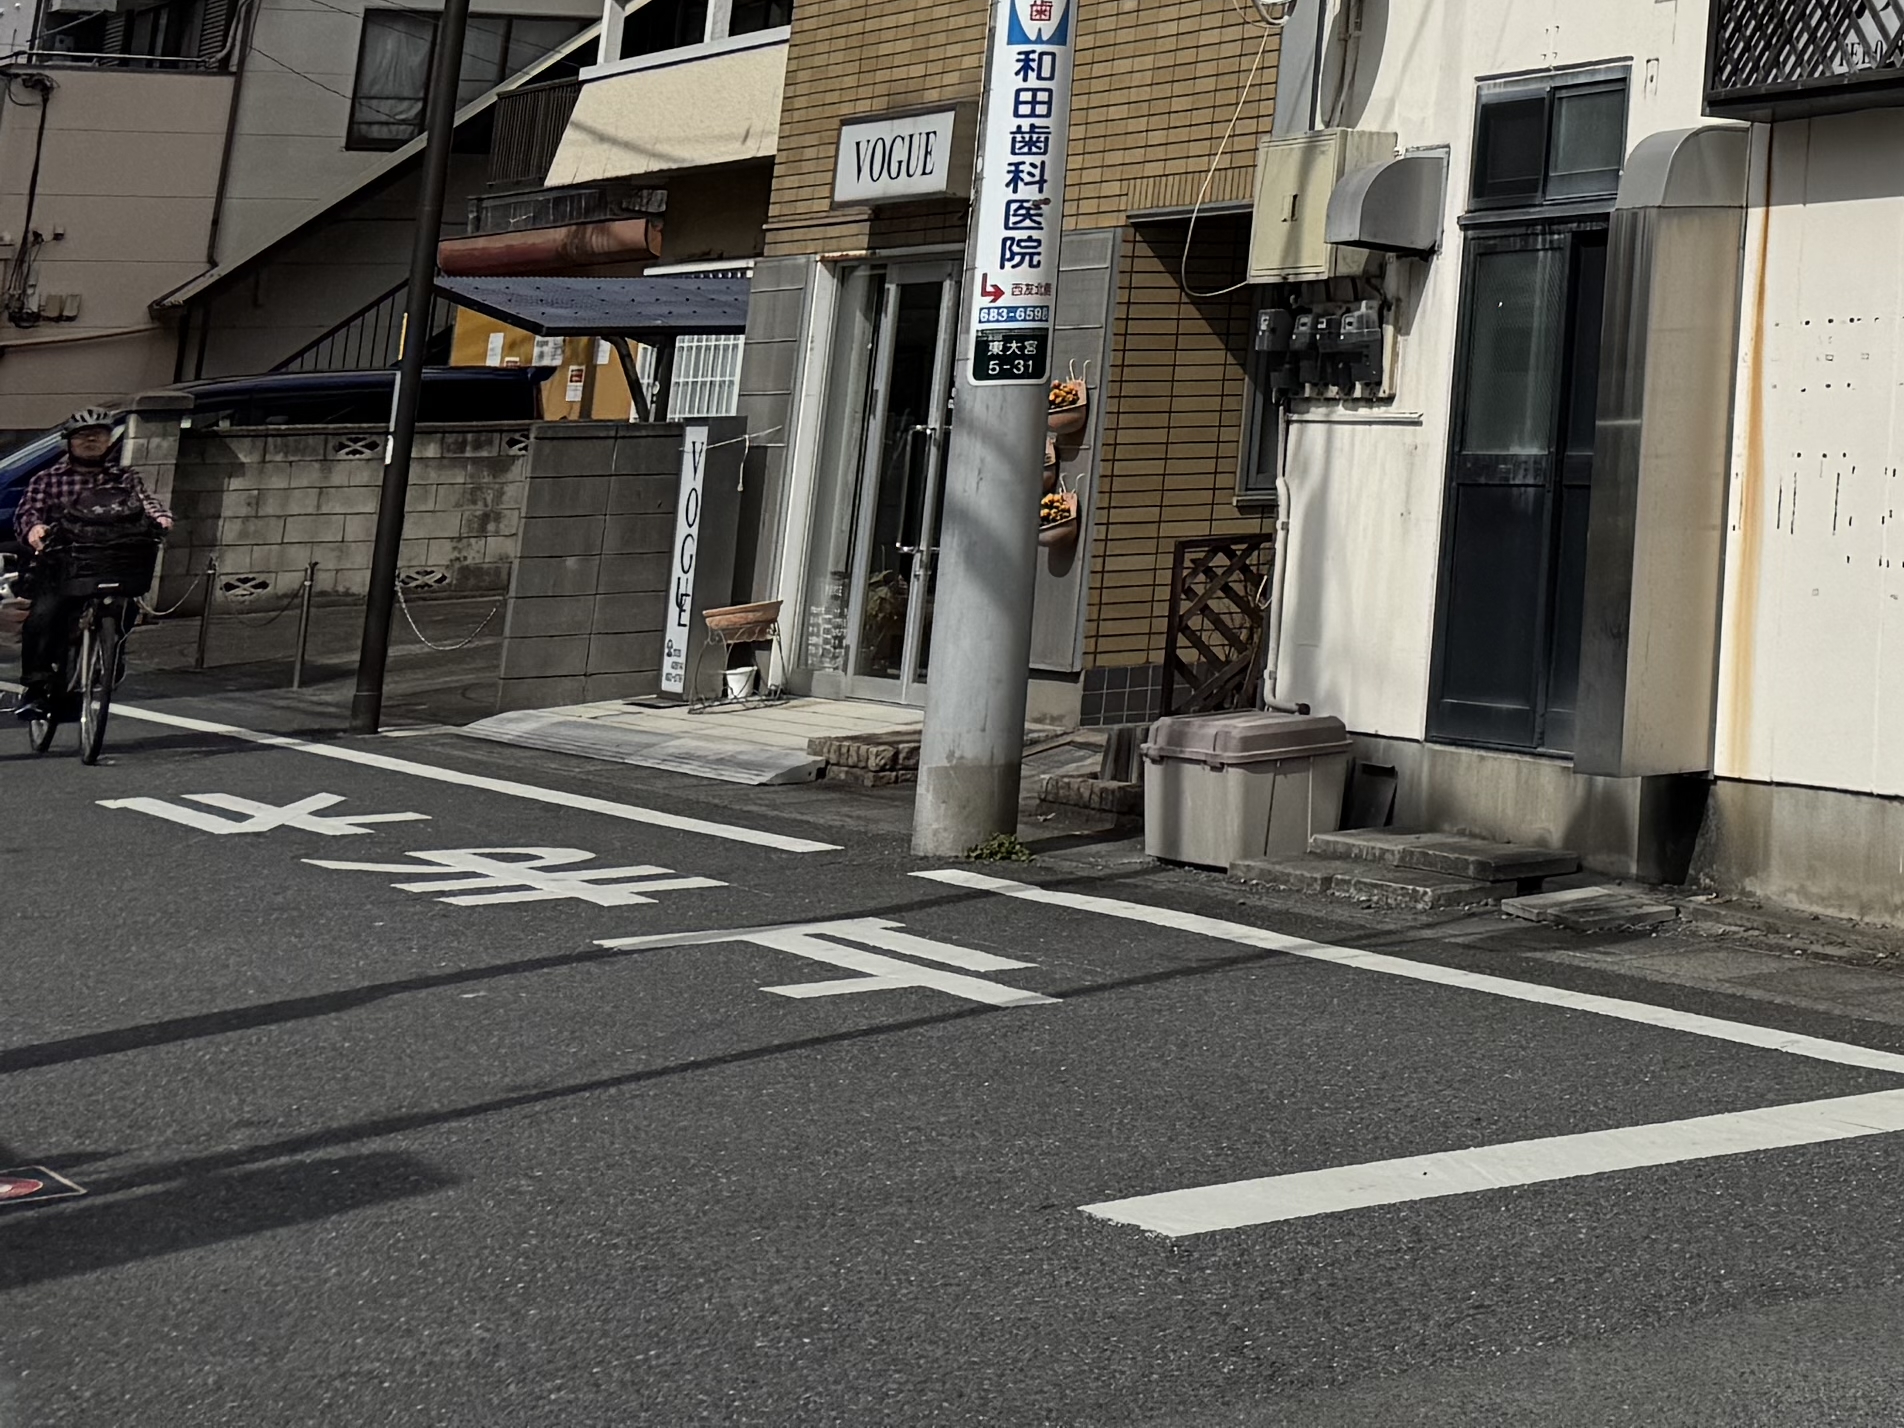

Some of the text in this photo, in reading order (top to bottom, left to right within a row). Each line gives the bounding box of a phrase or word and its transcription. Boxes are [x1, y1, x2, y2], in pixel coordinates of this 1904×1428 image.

[1029, 0, 1053, 22] 歯
[855, 130, 937, 184] VOGUE
[999, 49, 1056, 270] 和田歯科医院
[987, 340, 1038, 355] 東大宮
[988, 360, 1033, 374] 5-31
[676, 441, 704, 628] VOGUE
